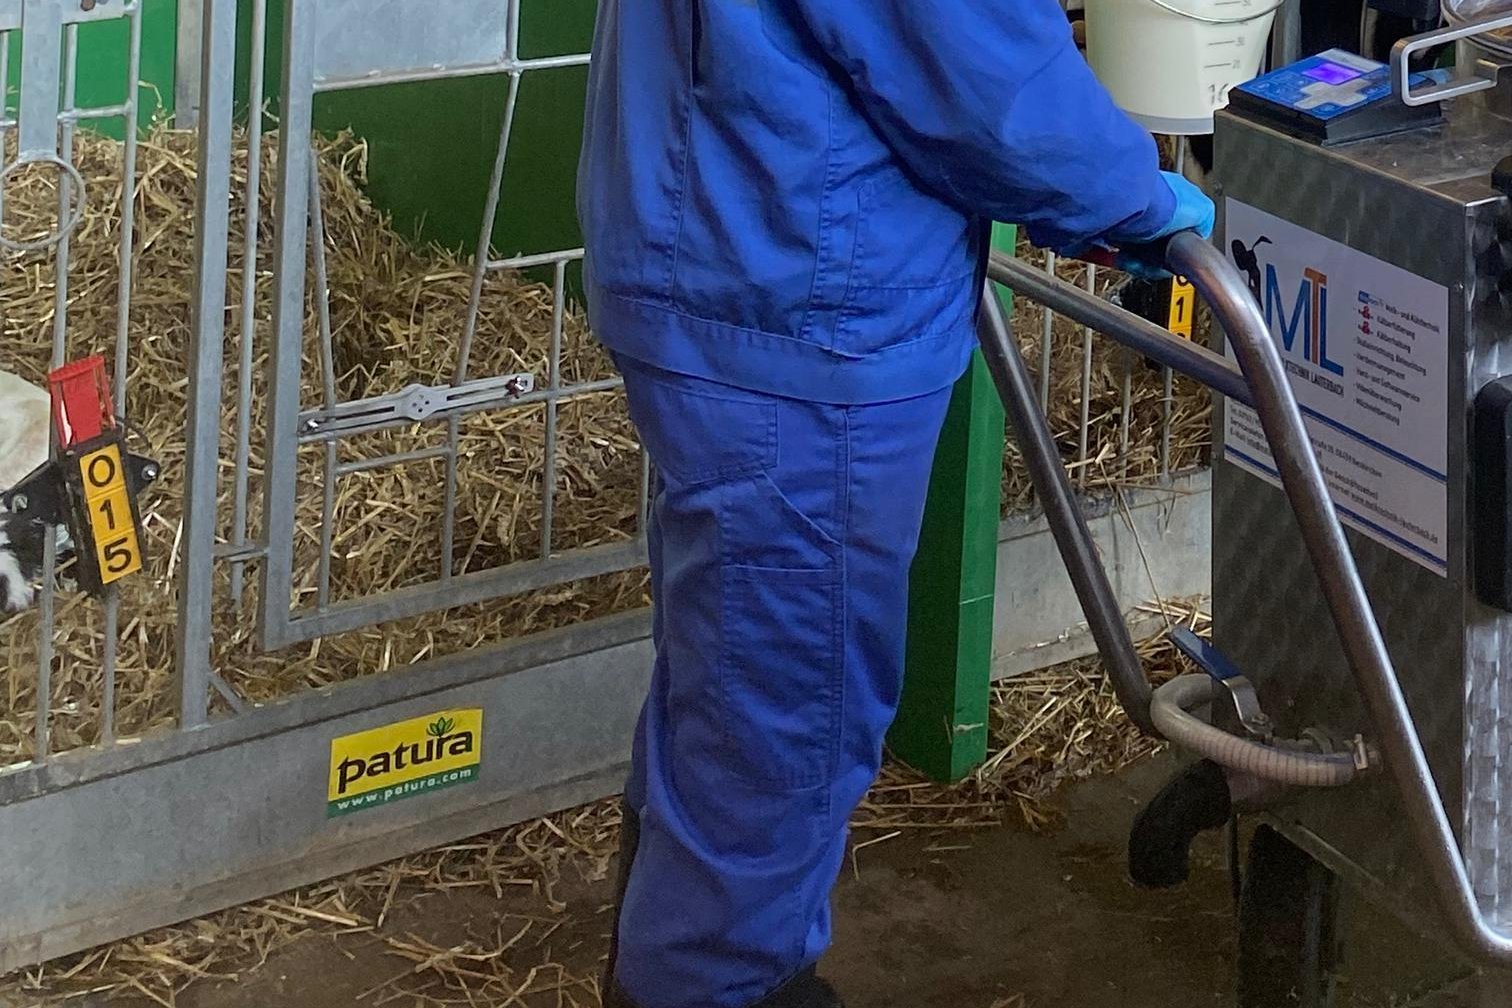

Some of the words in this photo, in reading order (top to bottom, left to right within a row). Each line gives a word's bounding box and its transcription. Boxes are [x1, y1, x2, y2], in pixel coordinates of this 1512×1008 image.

[88, 454, 132, 573] 015
[336, 731, 473, 794] patura
[337, 768, 472, 810] www.patura.com
